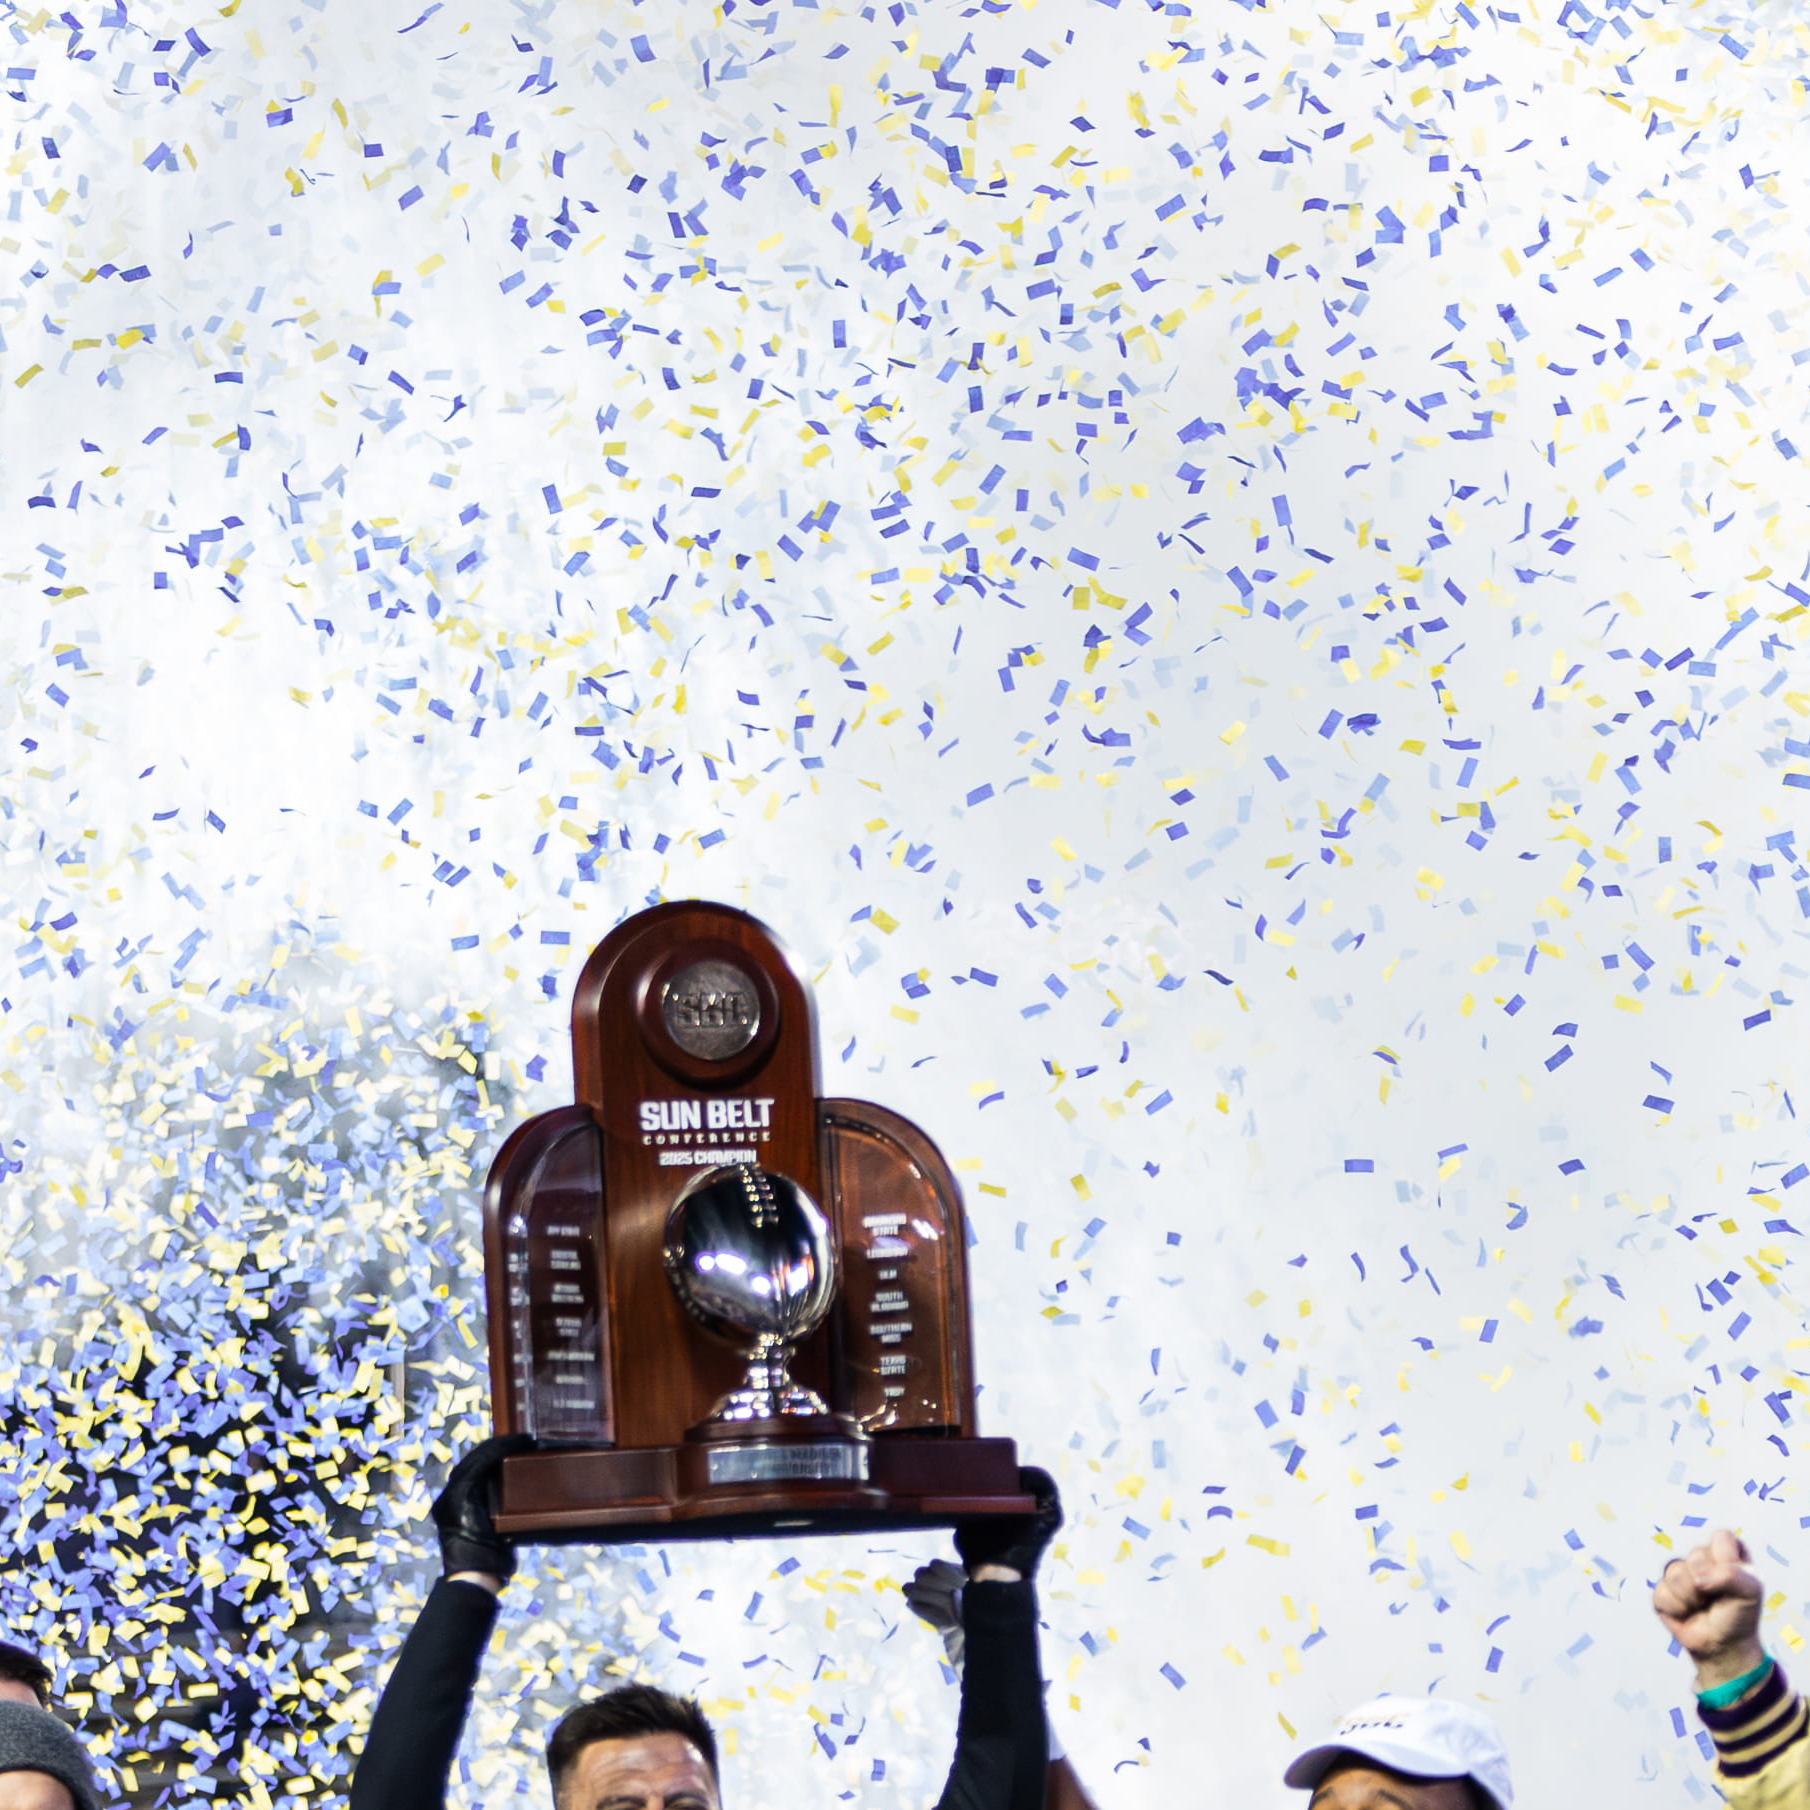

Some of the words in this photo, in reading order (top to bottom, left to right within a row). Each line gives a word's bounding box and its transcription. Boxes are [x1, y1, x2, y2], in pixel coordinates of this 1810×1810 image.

[641, 1100, 702, 1131] SUN
[707, 1099, 775, 1129] BELT
[642, 1130, 771, 1145] CONFERENCE
[659, 1152, 693, 1166] 2025
